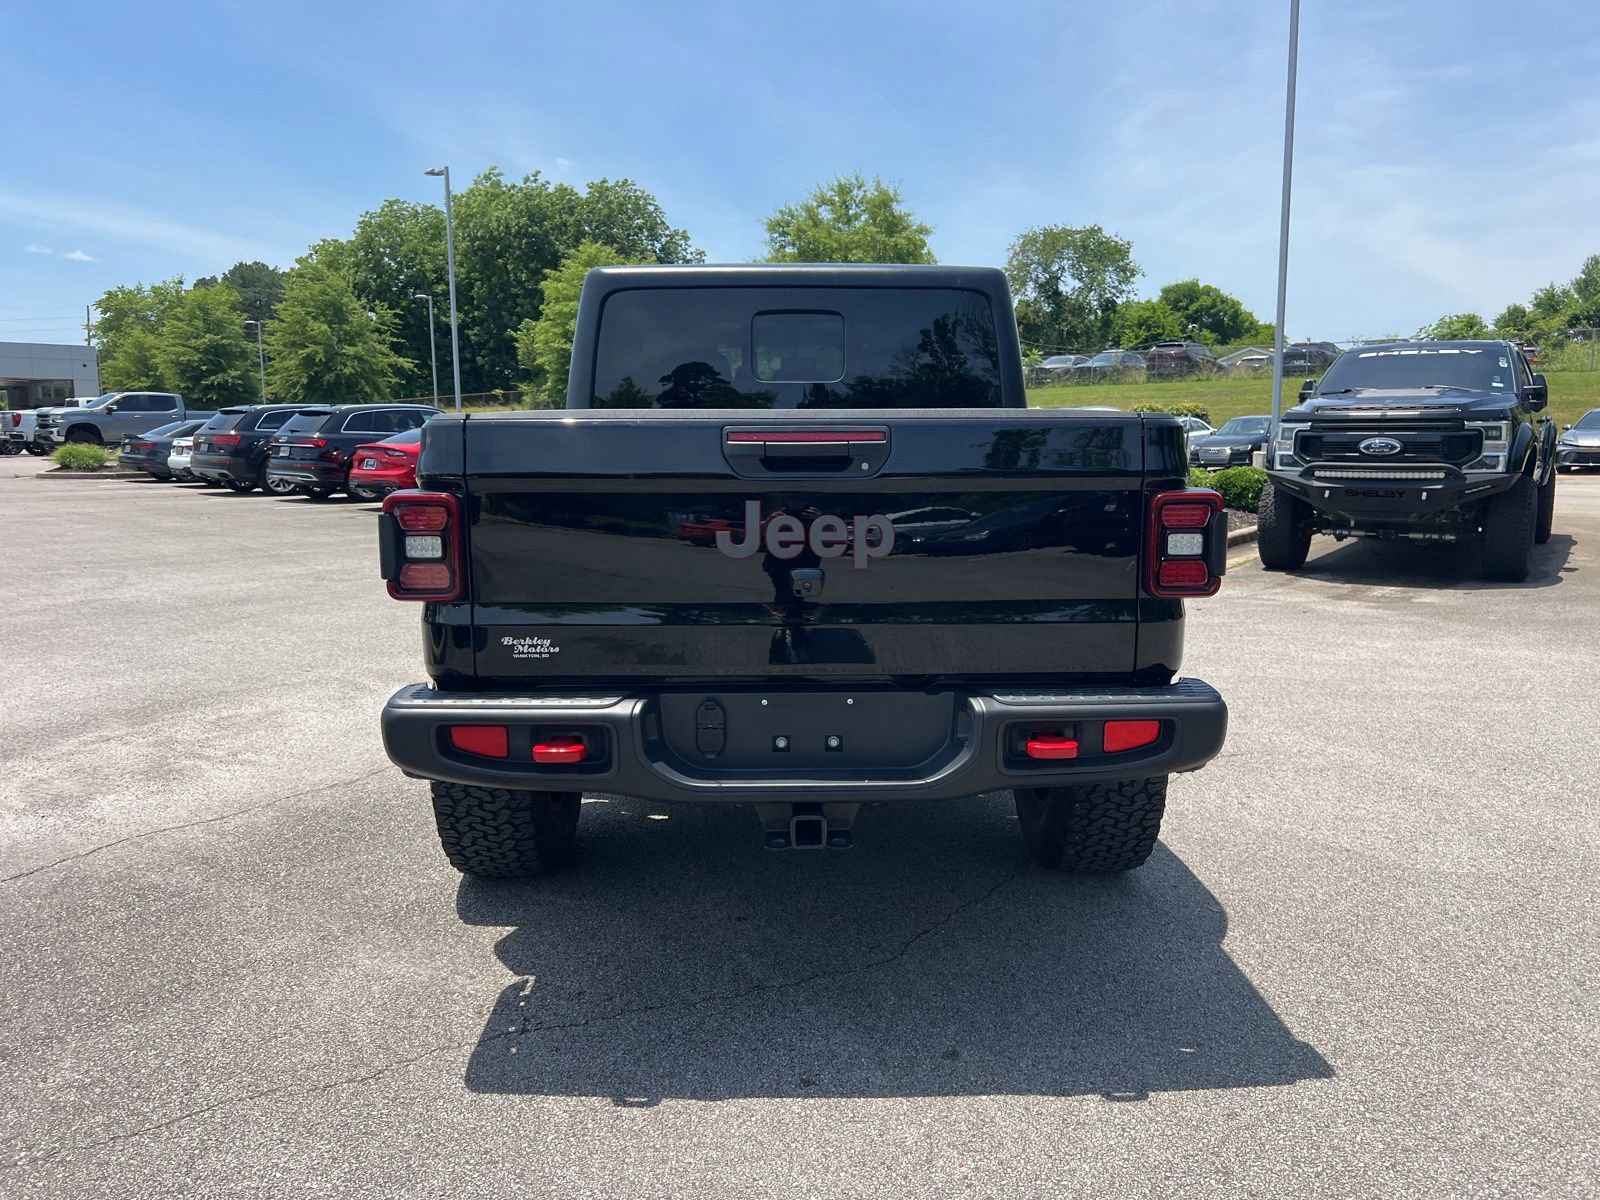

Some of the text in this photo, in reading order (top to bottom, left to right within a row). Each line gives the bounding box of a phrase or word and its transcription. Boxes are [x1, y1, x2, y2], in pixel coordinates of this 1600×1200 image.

[1344, 489, 1407, 498] SHELBY
[715, 500, 896, 569] Jeep
[501, 636, 551, 647] Berkley
[513, 645, 560, 653] Motors
